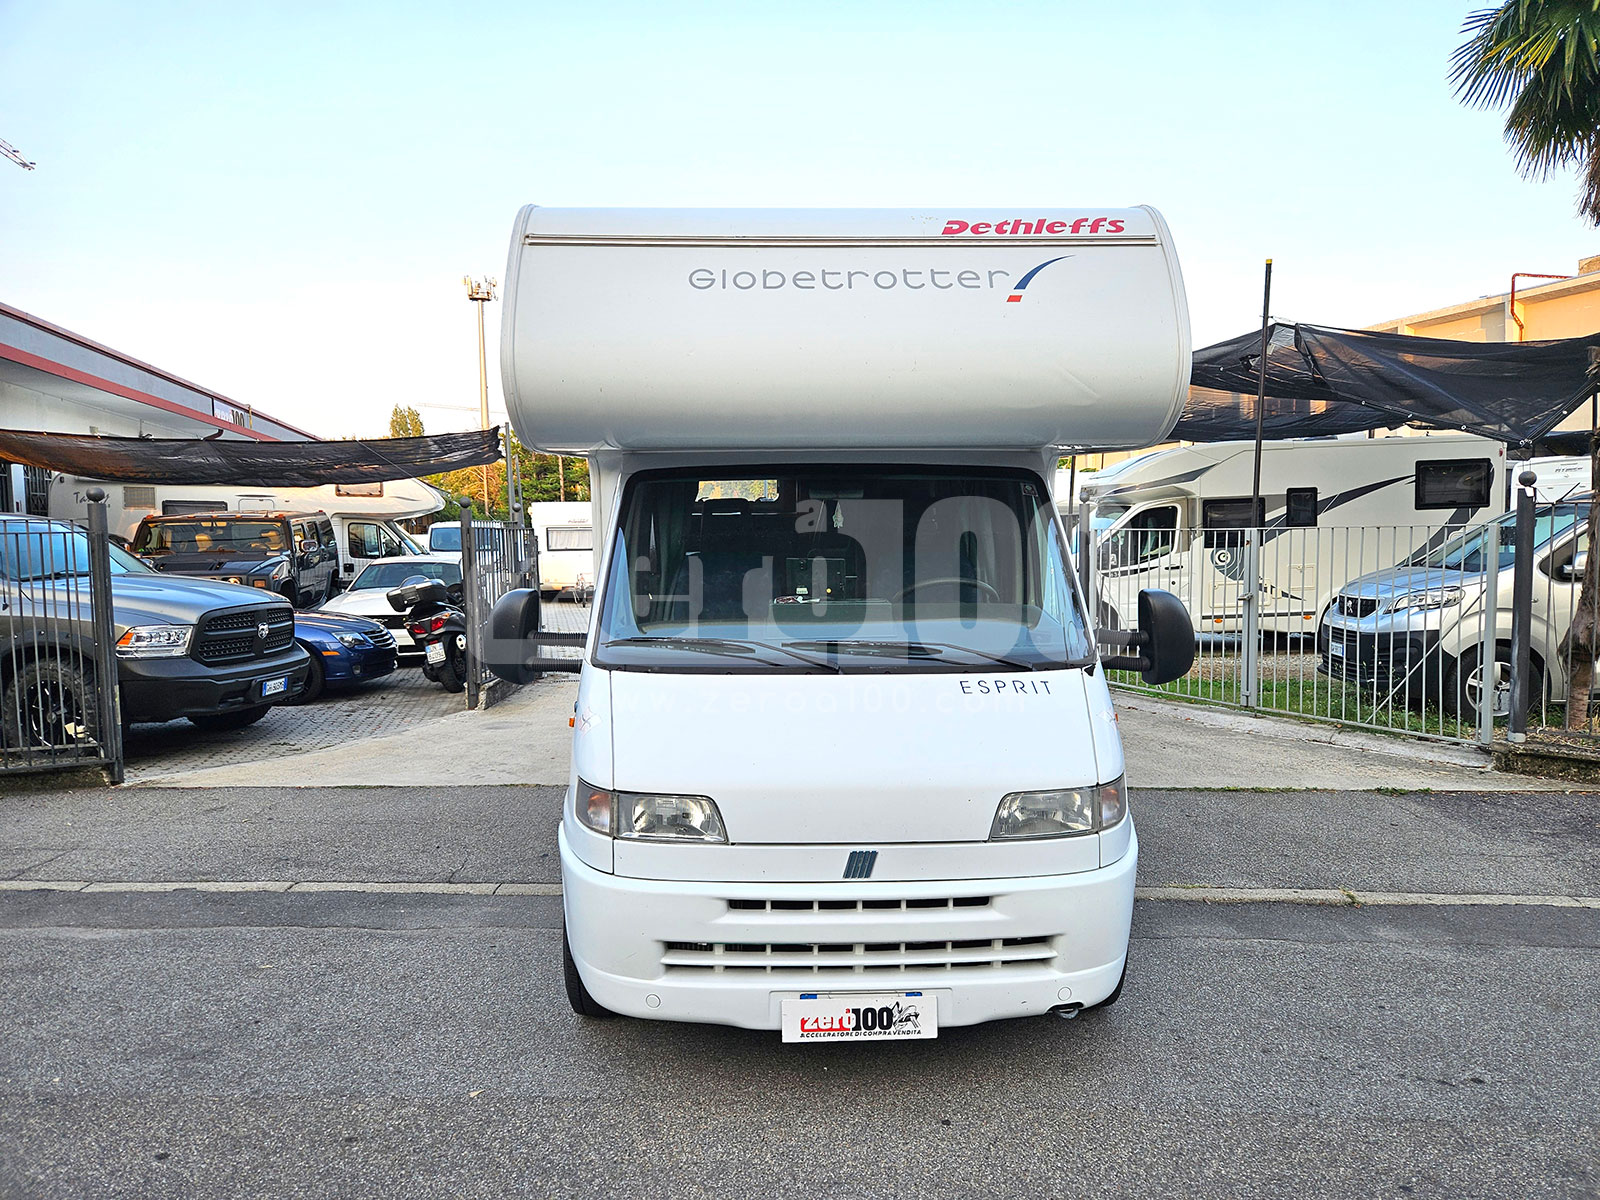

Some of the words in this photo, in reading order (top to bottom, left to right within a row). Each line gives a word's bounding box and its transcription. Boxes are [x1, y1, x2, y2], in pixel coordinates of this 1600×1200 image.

[942, 216, 1126, 236] Dethleffs
[688, 268, 1011, 290] Globetrotter
[960, 680, 1051, 695] ESPRIT
